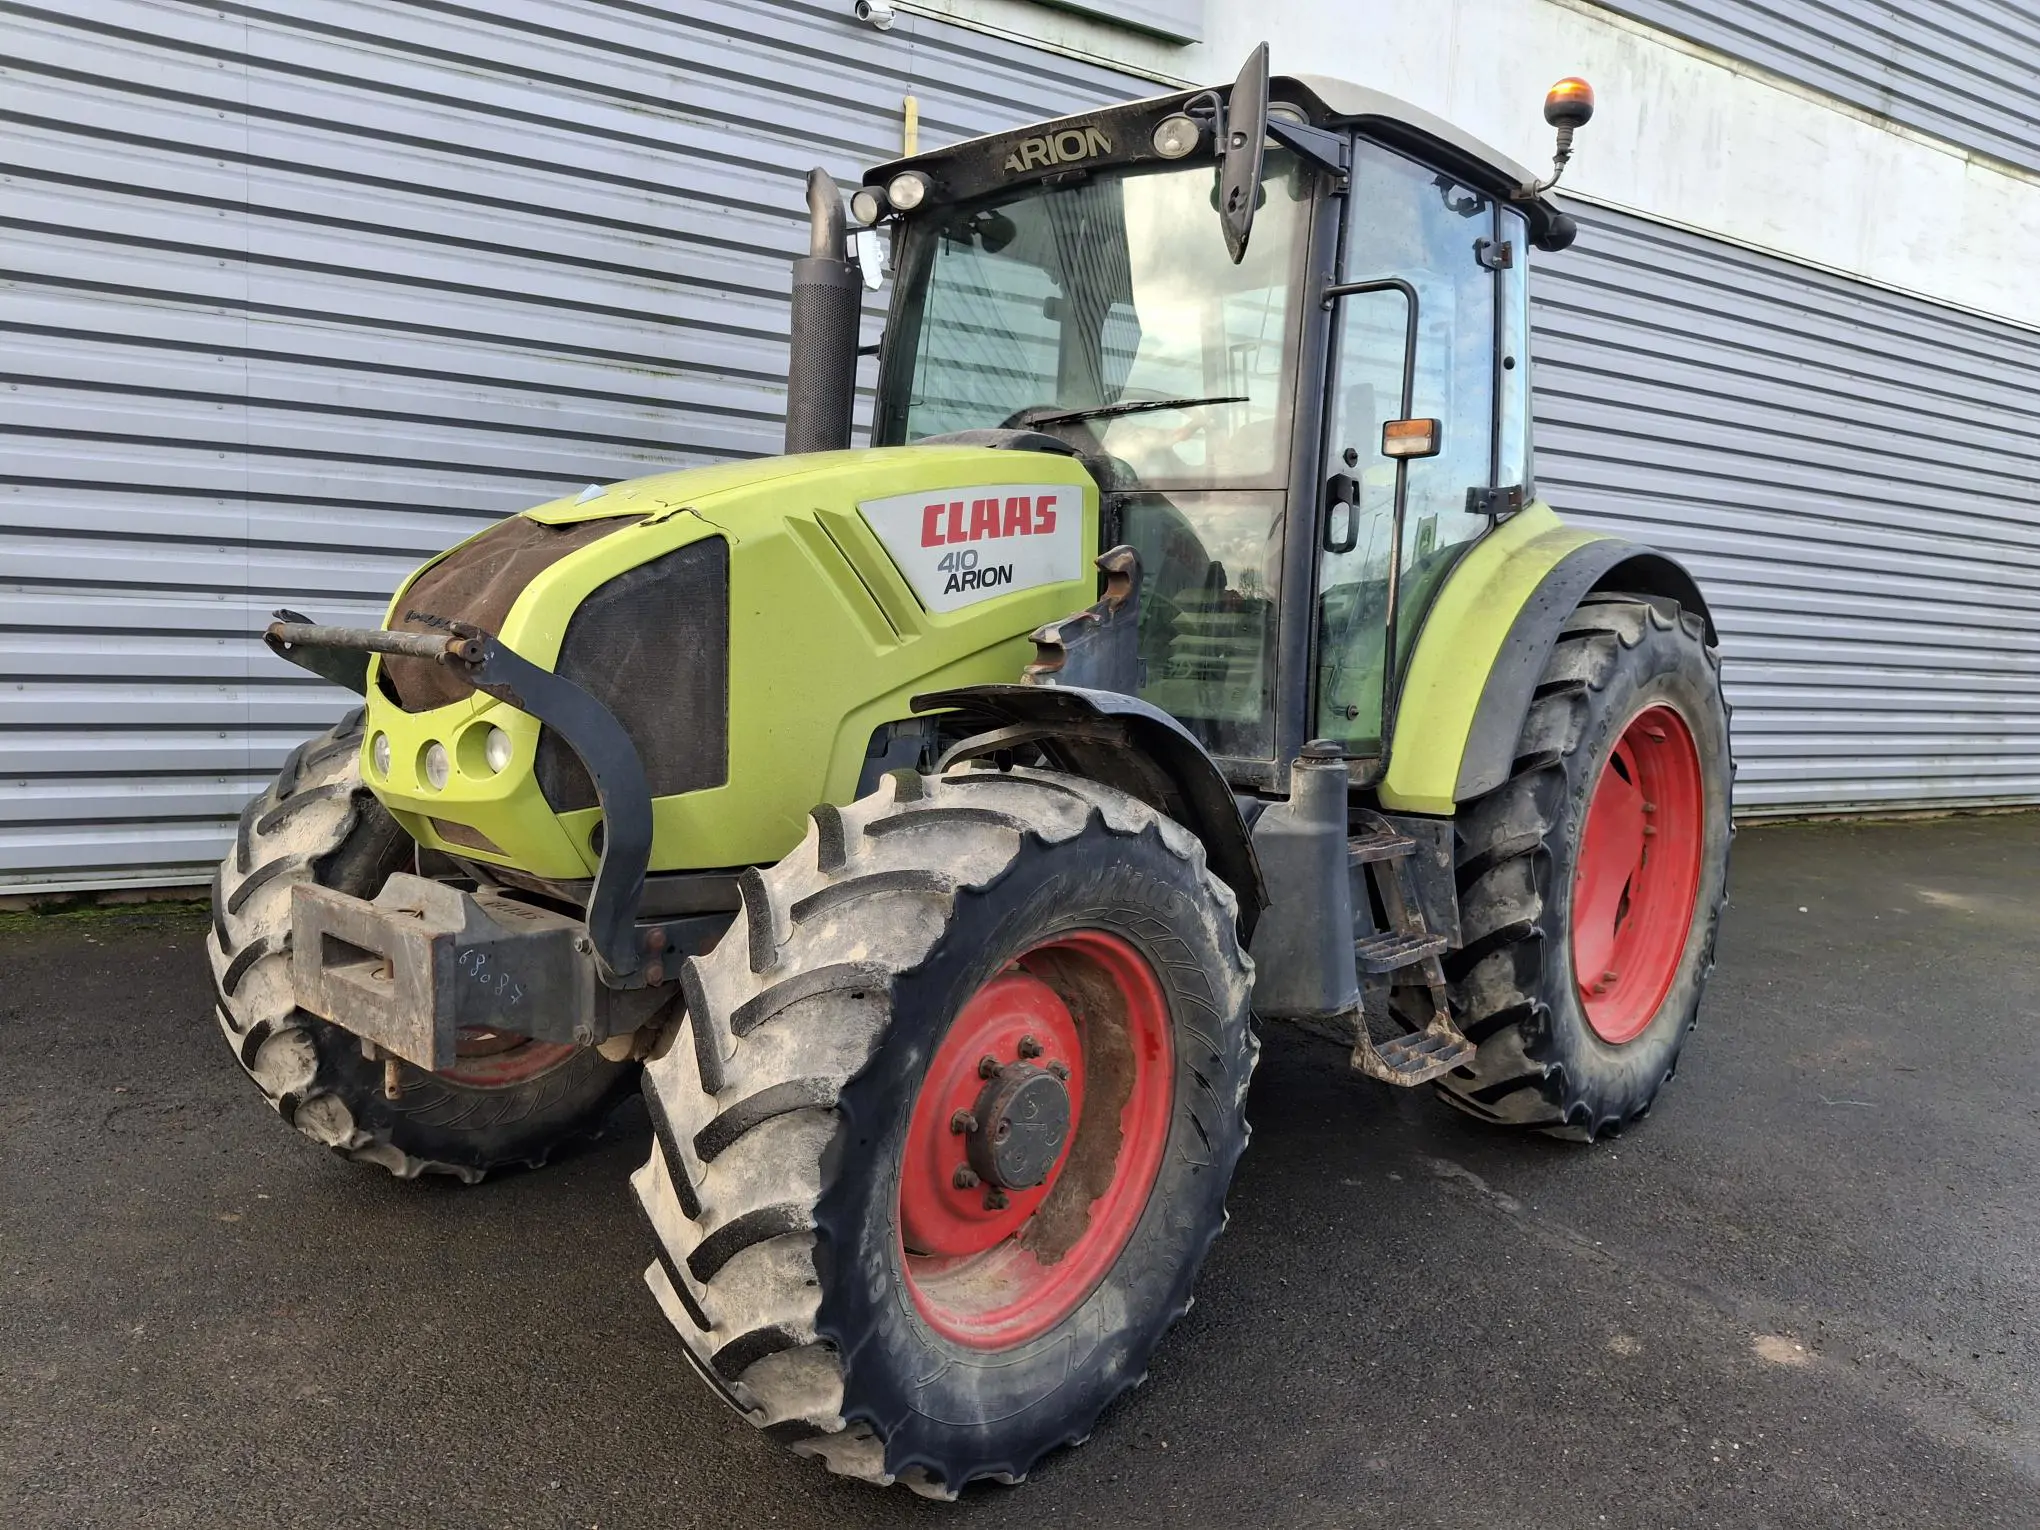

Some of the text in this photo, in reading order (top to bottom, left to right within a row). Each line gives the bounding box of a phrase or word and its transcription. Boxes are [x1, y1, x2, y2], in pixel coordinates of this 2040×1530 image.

[1003, 127, 1112, 173] ARION
[921, 495, 1057, 548] CLAAS
[937, 549, 978, 573] 410
[944, 563, 1013, 594] ARION
